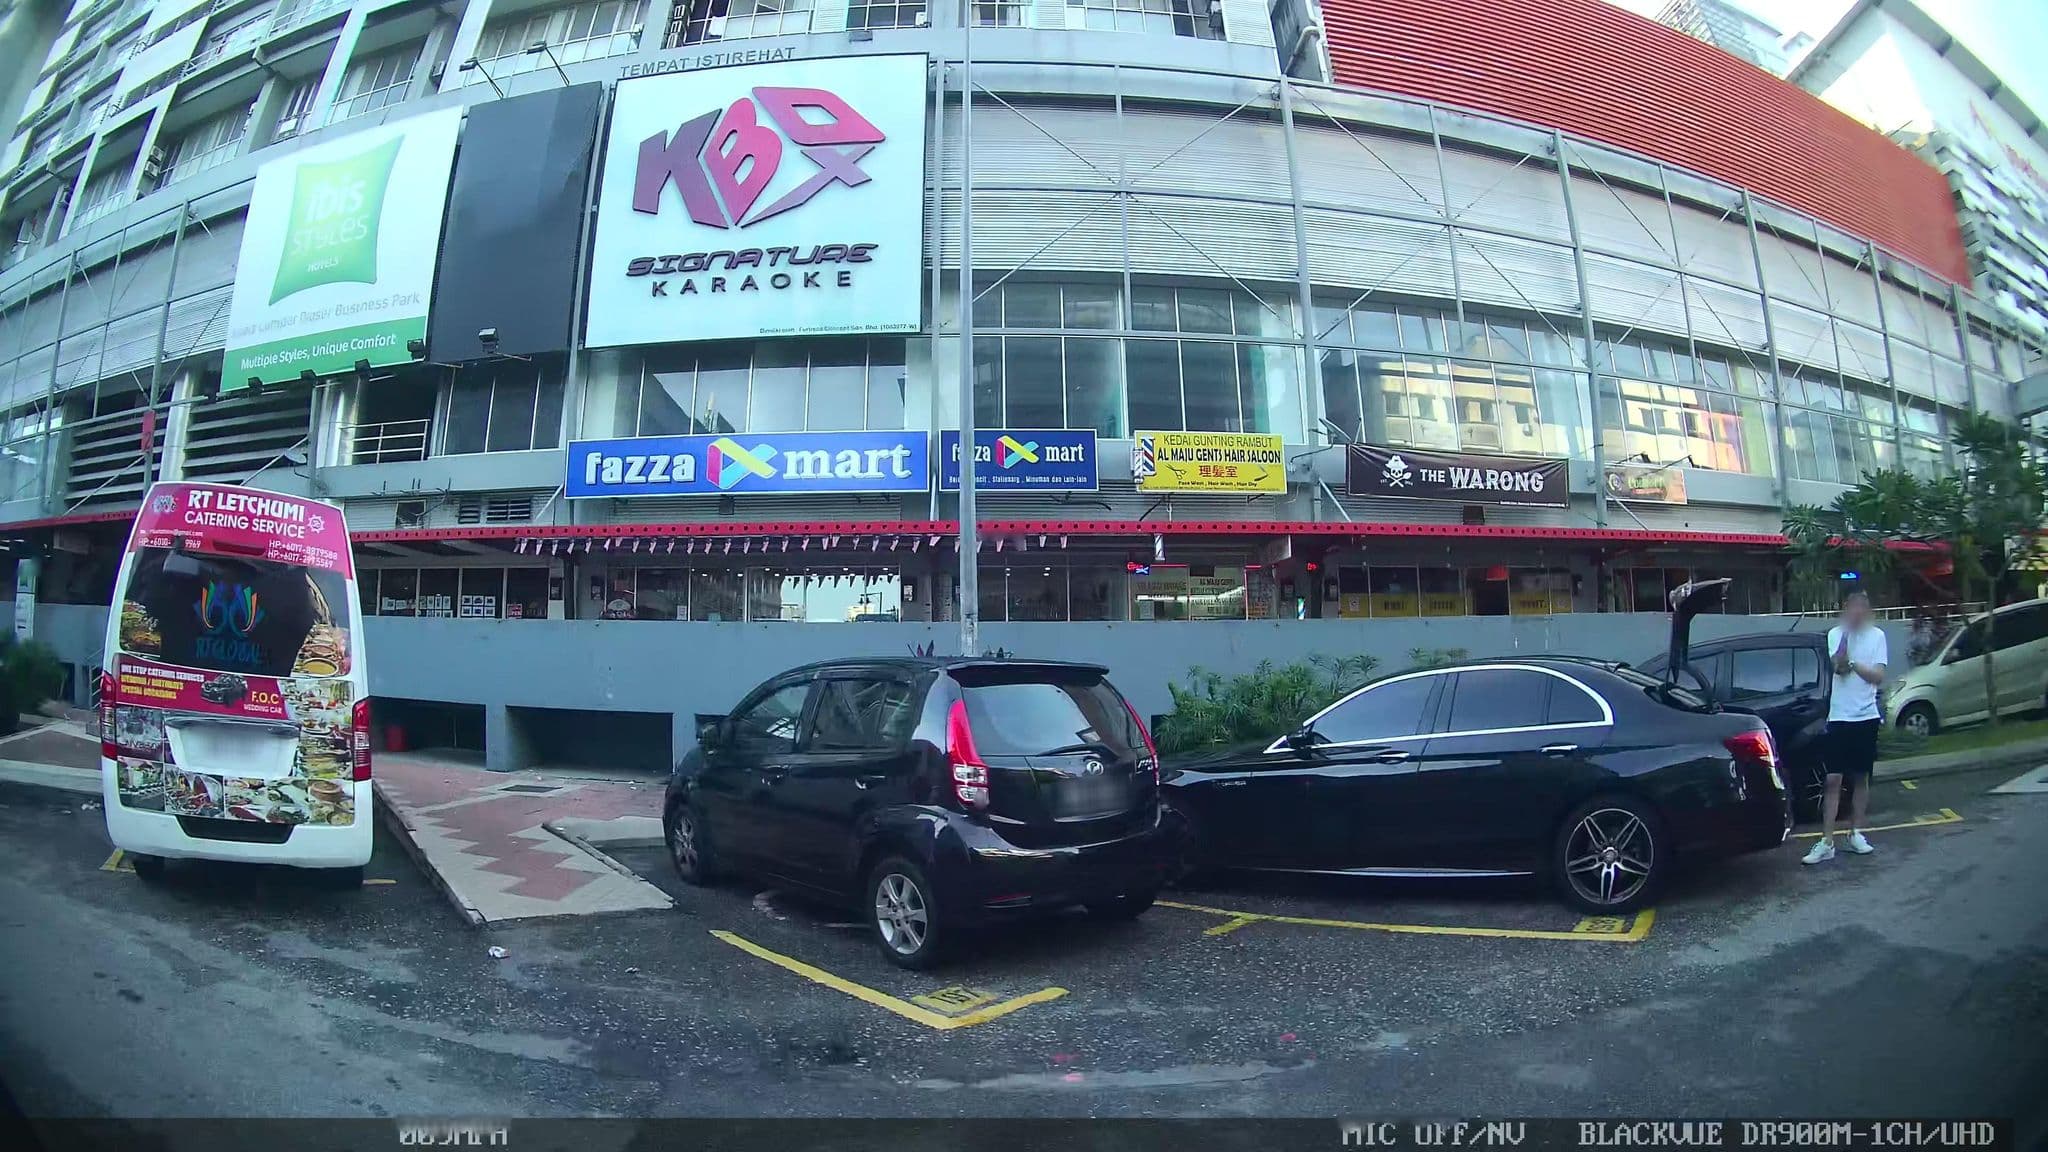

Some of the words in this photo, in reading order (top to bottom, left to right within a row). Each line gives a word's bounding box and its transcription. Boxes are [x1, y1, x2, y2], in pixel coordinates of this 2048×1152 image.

[620, 58, 690, 78] TEMPAT
[696, 47, 796, 68] ISTIREHAT
[306, 174, 366, 224] ibis
[626, 243, 879, 277] SIGNATURE
[652, 270, 852, 297] KARAOKE
[391, 290, 420, 307] Park
[240, 352, 279, 371] Multiple
[279, 347, 310, 364] Styles,
[312, 339, 349, 357] Unique
[350, 332, 397, 351] Comfort
[1045, 443, 1084, 461] mart
[1163, 434, 1191, 446] KEDAI
[1194, 435, 1234, 447] GUNTING
[1236, 437, 1272, 448] RAMBUT
[585, 452, 696, 485] fazza
[782, 443, 912, 480] mart
[1157, 448, 1169, 461] AL
[1171, 448, 1193, 463] MAJU
[1195, 449, 1223, 462] GENTS
[1225, 450, 1245, 463] HAIR
[1247, 450, 1281, 463] SALOON
[1199, 465, 1238, 478] 理髮室
[1419, 468, 1446, 483] THE
[1448, 466, 1545, 493] WARONG
[188, 489, 213, 509] RT
[216, 492, 305, 522] LETCHUMI
[184, 510, 249, 530] CATERING
[252, 517, 305, 539] SERVICE
[252, 691, 279, 704] F.O.C
